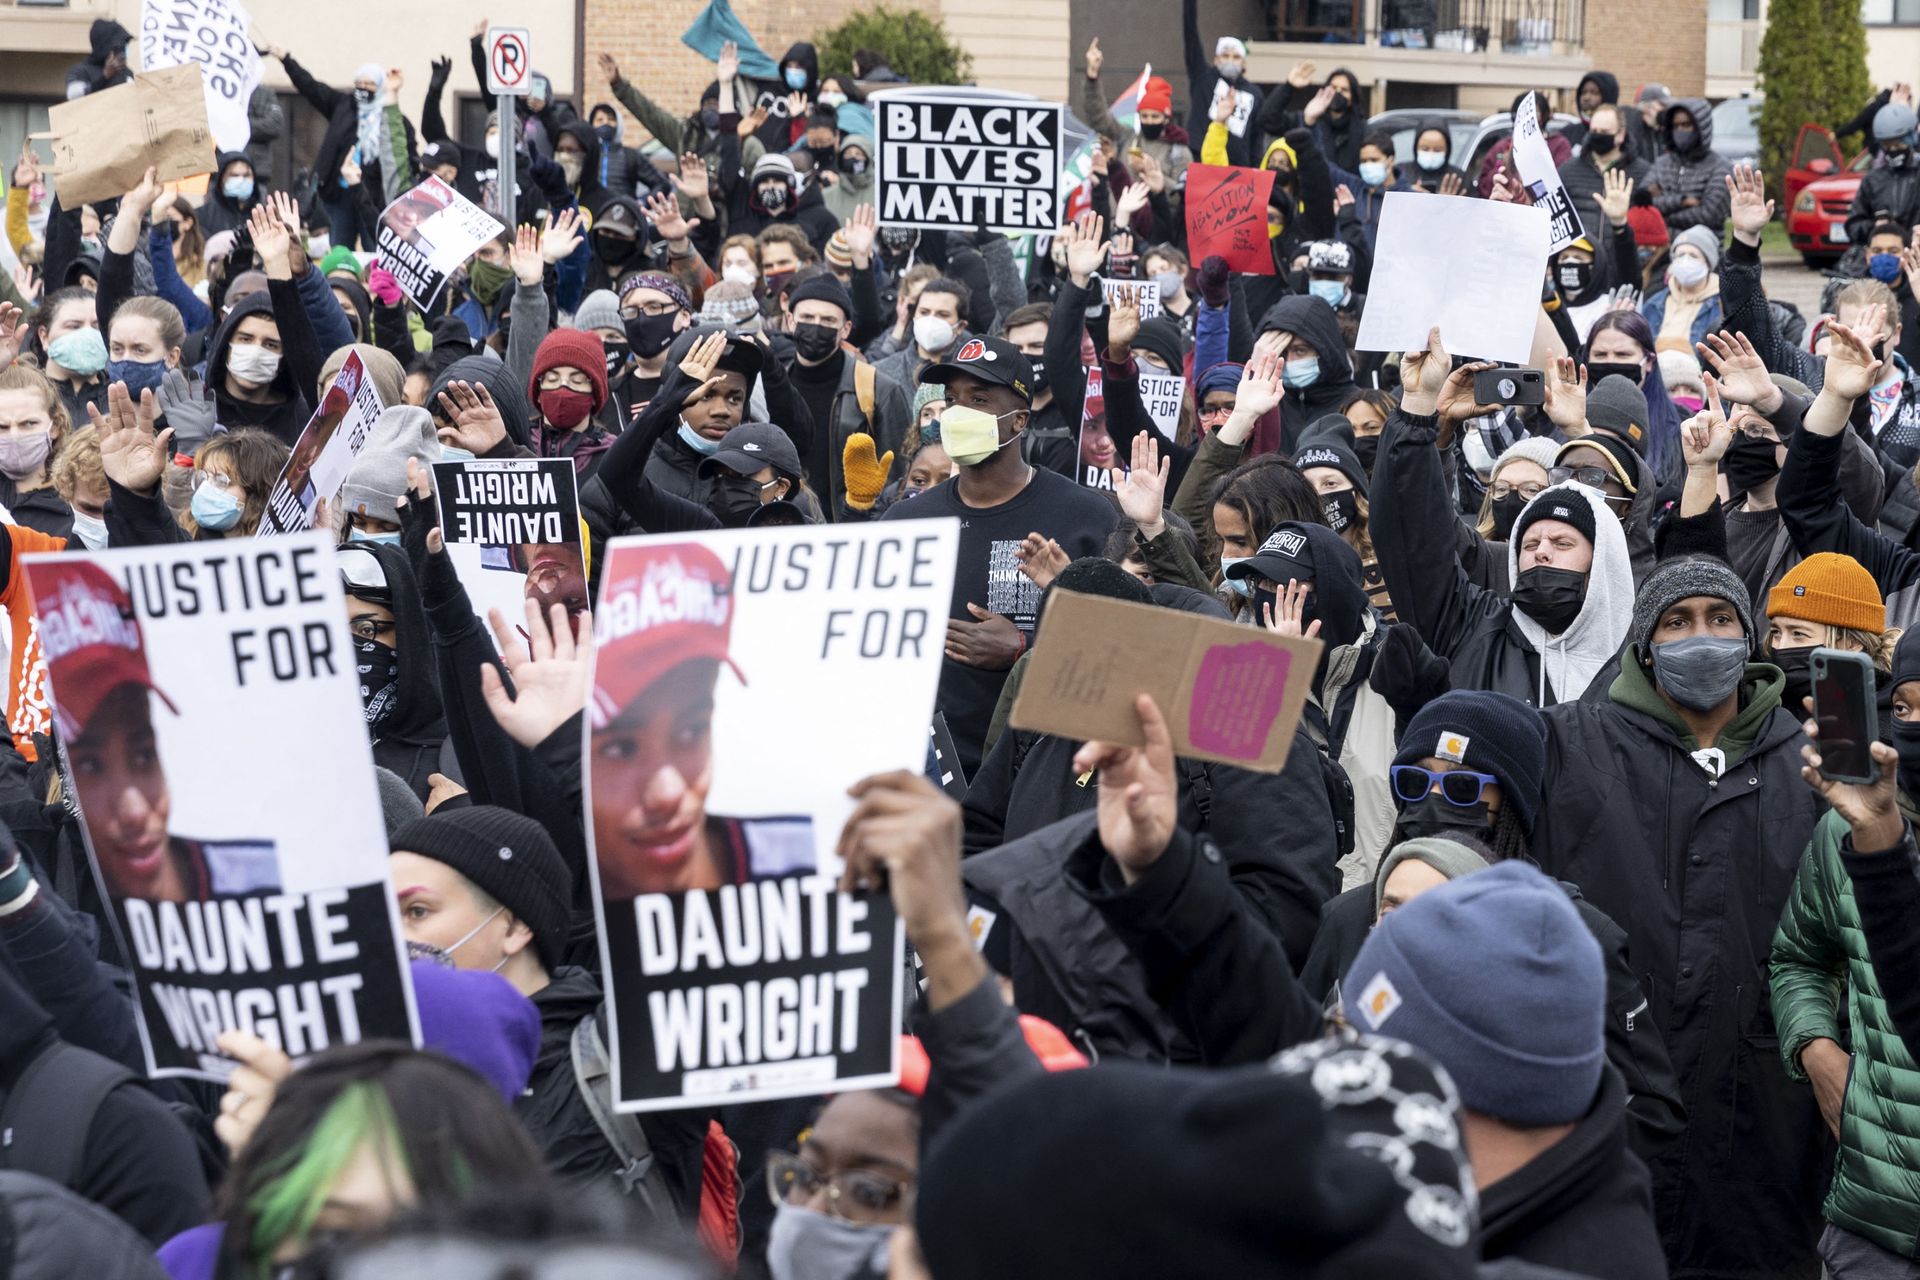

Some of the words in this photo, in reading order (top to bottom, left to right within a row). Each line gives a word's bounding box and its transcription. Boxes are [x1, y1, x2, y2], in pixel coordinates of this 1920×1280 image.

[887, 104, 1051, 147] BLACK
[897, 146, 1042, 185] LIVES
[453, 200, 498, 232] USTICE
[883, 183, 1054, 227] MATTER
[1213, 196, 1255, 232] NOW
[1551, 213, 1573, 245] GHT
[376, 244, 428, 297] WRIGHT
[379, 226, 439, 284] DAUNTE
[1140, 378, 1180, 397] STICE
[1150, 401, 1177, 417] FOR
[455, 473, 557, 505] WRIGHT
[456, 512, 563, 544] DAUNTE
[1331, 517, 1347, 530] TTER
[118, 546, 327, 620] JUSTICE
[713, 535, 939, 596] JUSTICE
[988, 569, 1018, 582] THANK
[230, 621, 337, 687] FOR
[821, 608, 928, 660] FOR
[123, 886, 360, 975] DAUNTE
[634, 874, 872, 976] DAUNTE
[150, 972, 364, 1057] WRIGHT
[647, 967, 869, 1073] WRIGHT
